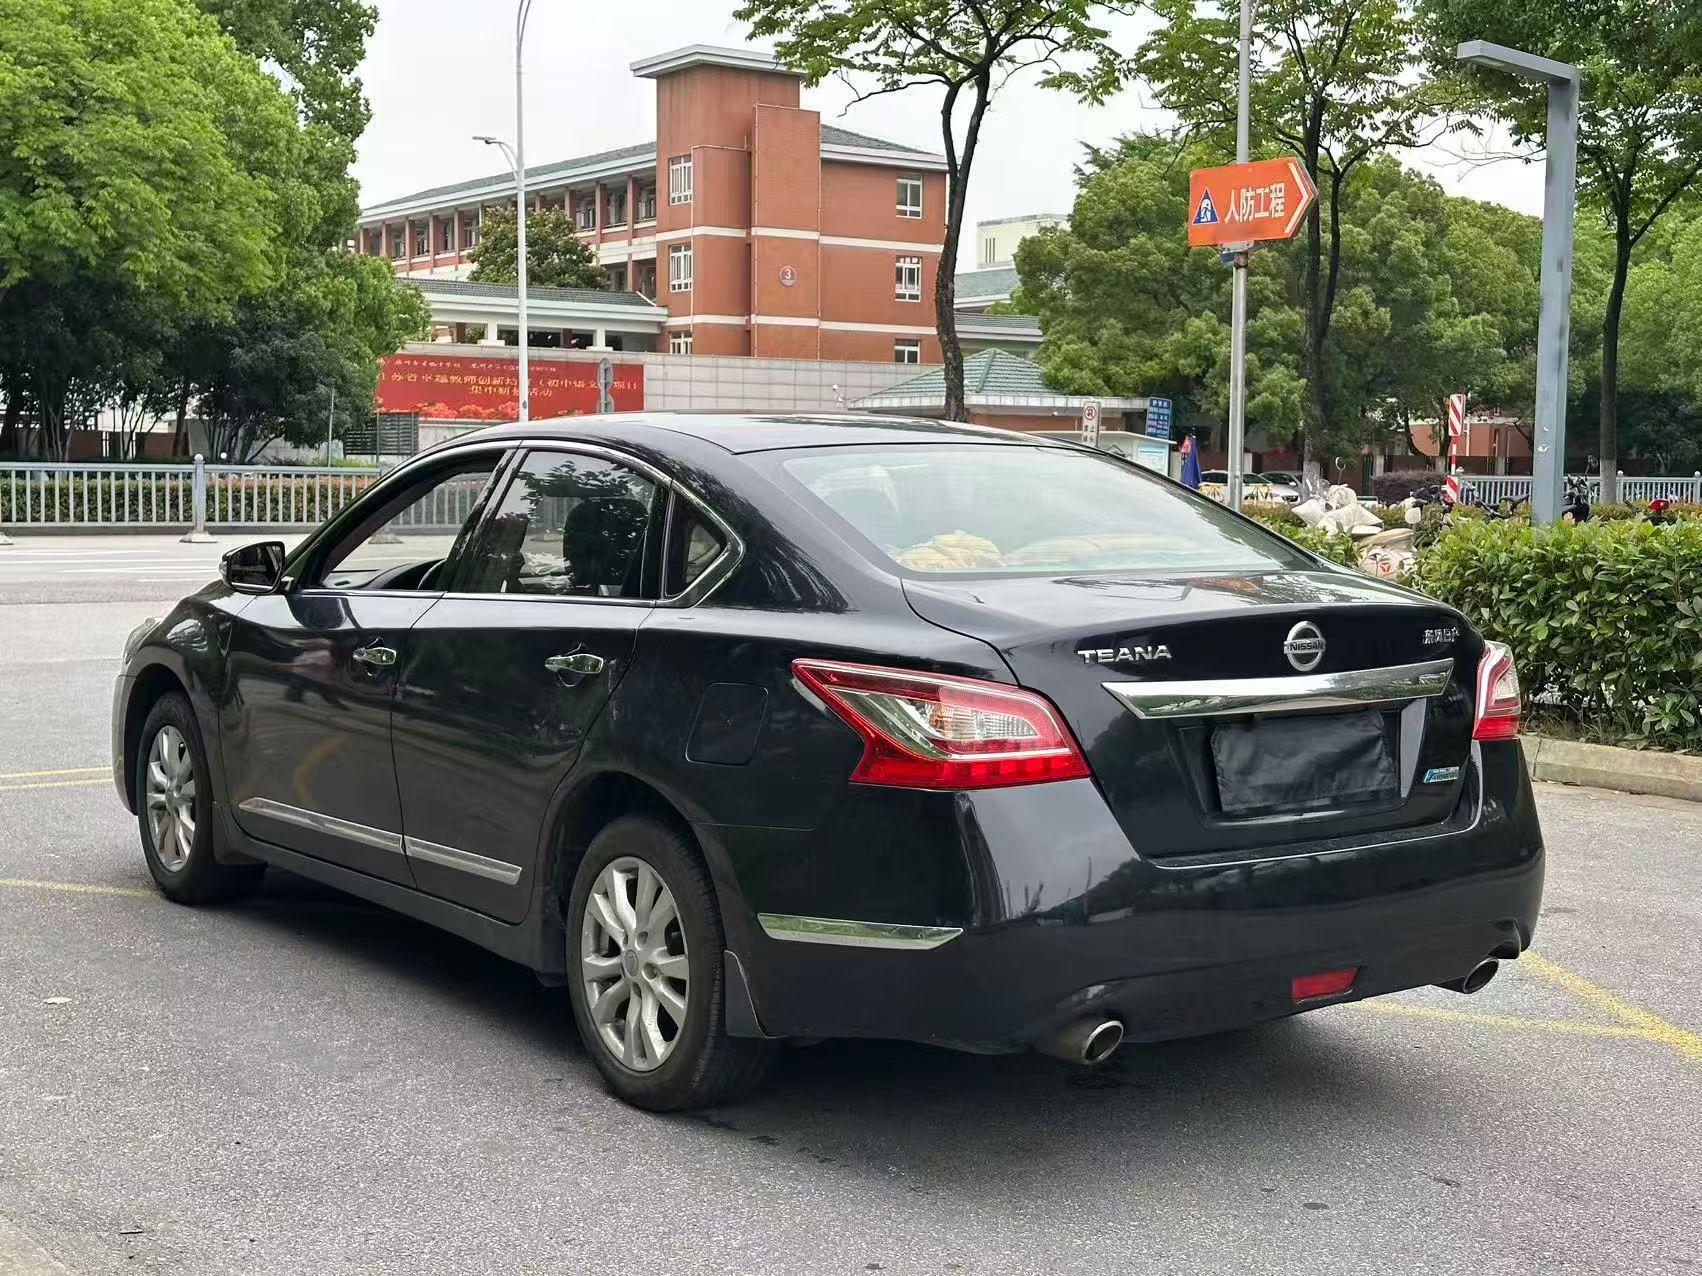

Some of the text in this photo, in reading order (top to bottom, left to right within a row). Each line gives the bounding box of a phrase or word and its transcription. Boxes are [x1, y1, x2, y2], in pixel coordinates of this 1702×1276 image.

[1223, 182, 1285, 224] 人防工程
[784, 268, 792, 280] 3
[1289, 640, 1325, 652] NISSAN
[1076, 644, 1173, 665] TEANA
